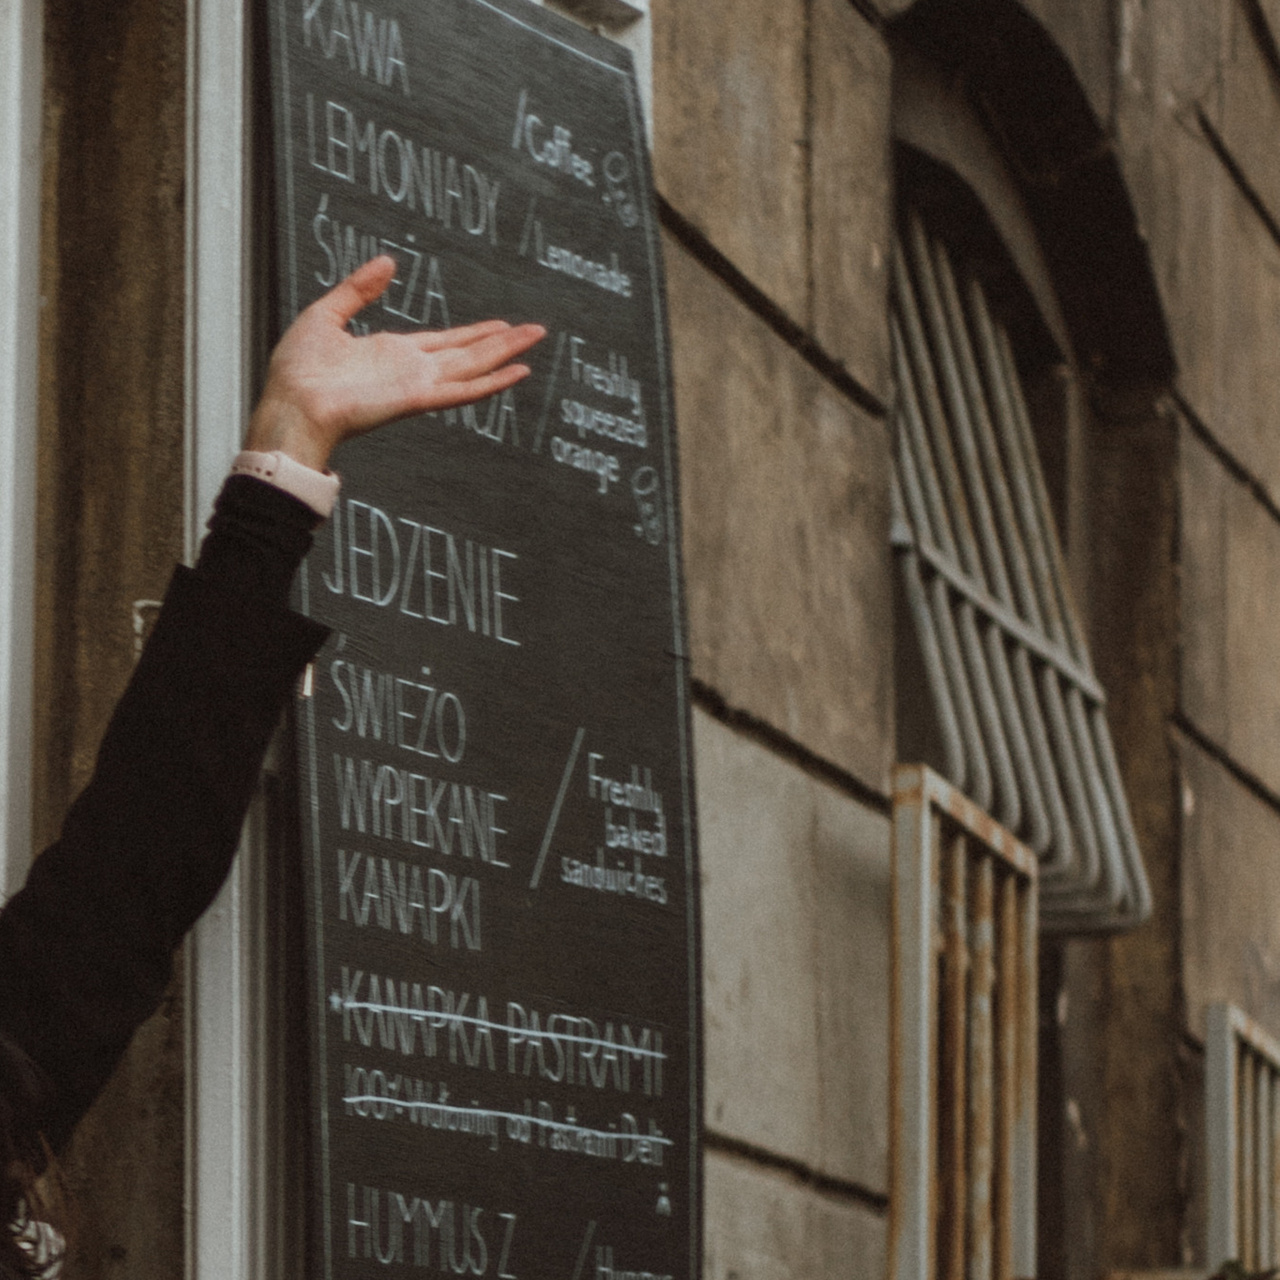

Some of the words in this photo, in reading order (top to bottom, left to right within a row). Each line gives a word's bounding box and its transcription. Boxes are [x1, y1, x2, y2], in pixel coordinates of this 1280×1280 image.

[307, 93, 500, 246] LEMONIADY
[551, 436, 620, 494] orange
[322, 496, 521, 647] JEDZENIE
[331, 632, 467, 764] ŚWIEŻO
[560, 846, 668, 905] sandwiches
[605, 806, 668, 858] baked
[336, 848, 482, 952] KANAPKI
[347, 1182, 488, 1276] HUMMUS
[497, 1212, 518, 1280] Z
